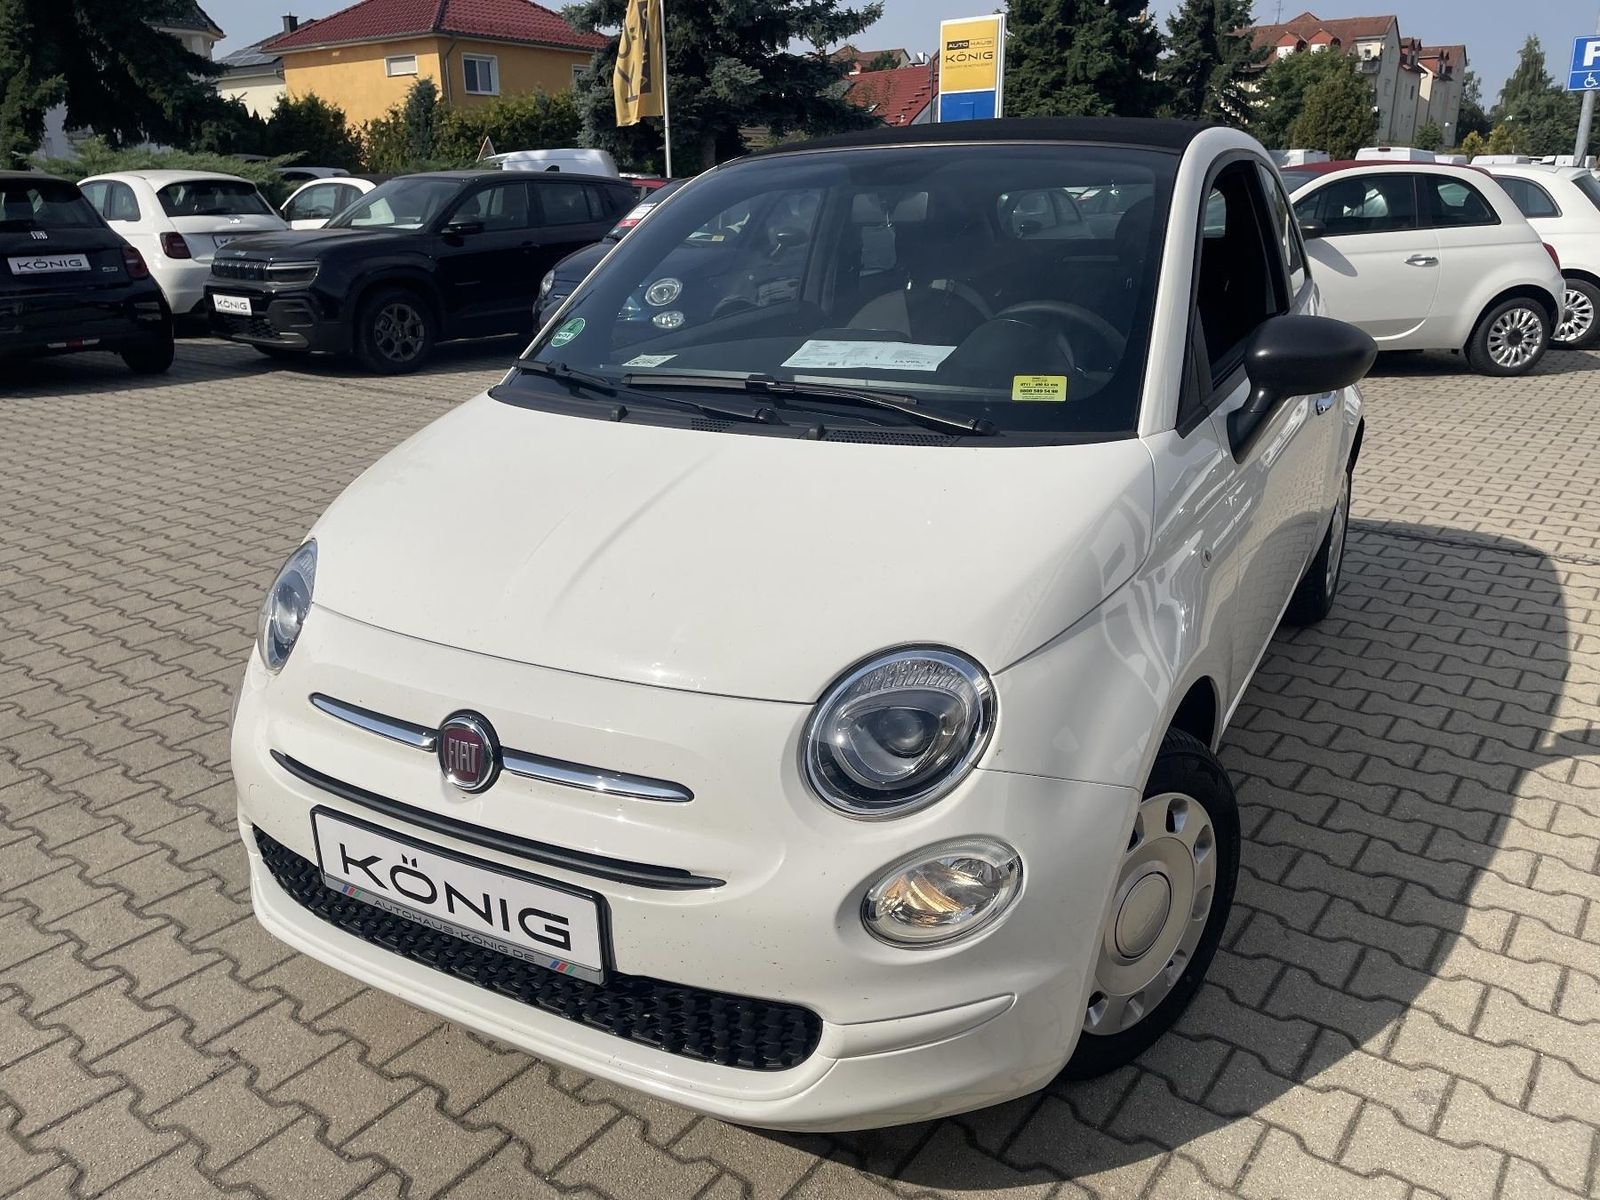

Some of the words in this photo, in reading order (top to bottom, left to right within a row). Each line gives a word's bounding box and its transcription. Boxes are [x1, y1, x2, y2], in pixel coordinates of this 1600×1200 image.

[945, 51, 993, 62] KÖNIG
[1583, 41, 1600, 67] P
[17, 258, 83, 271] KÖNIG
[448, 737, 479, 774] FIAT
[340, 843, 572, 951] KÖNIG
